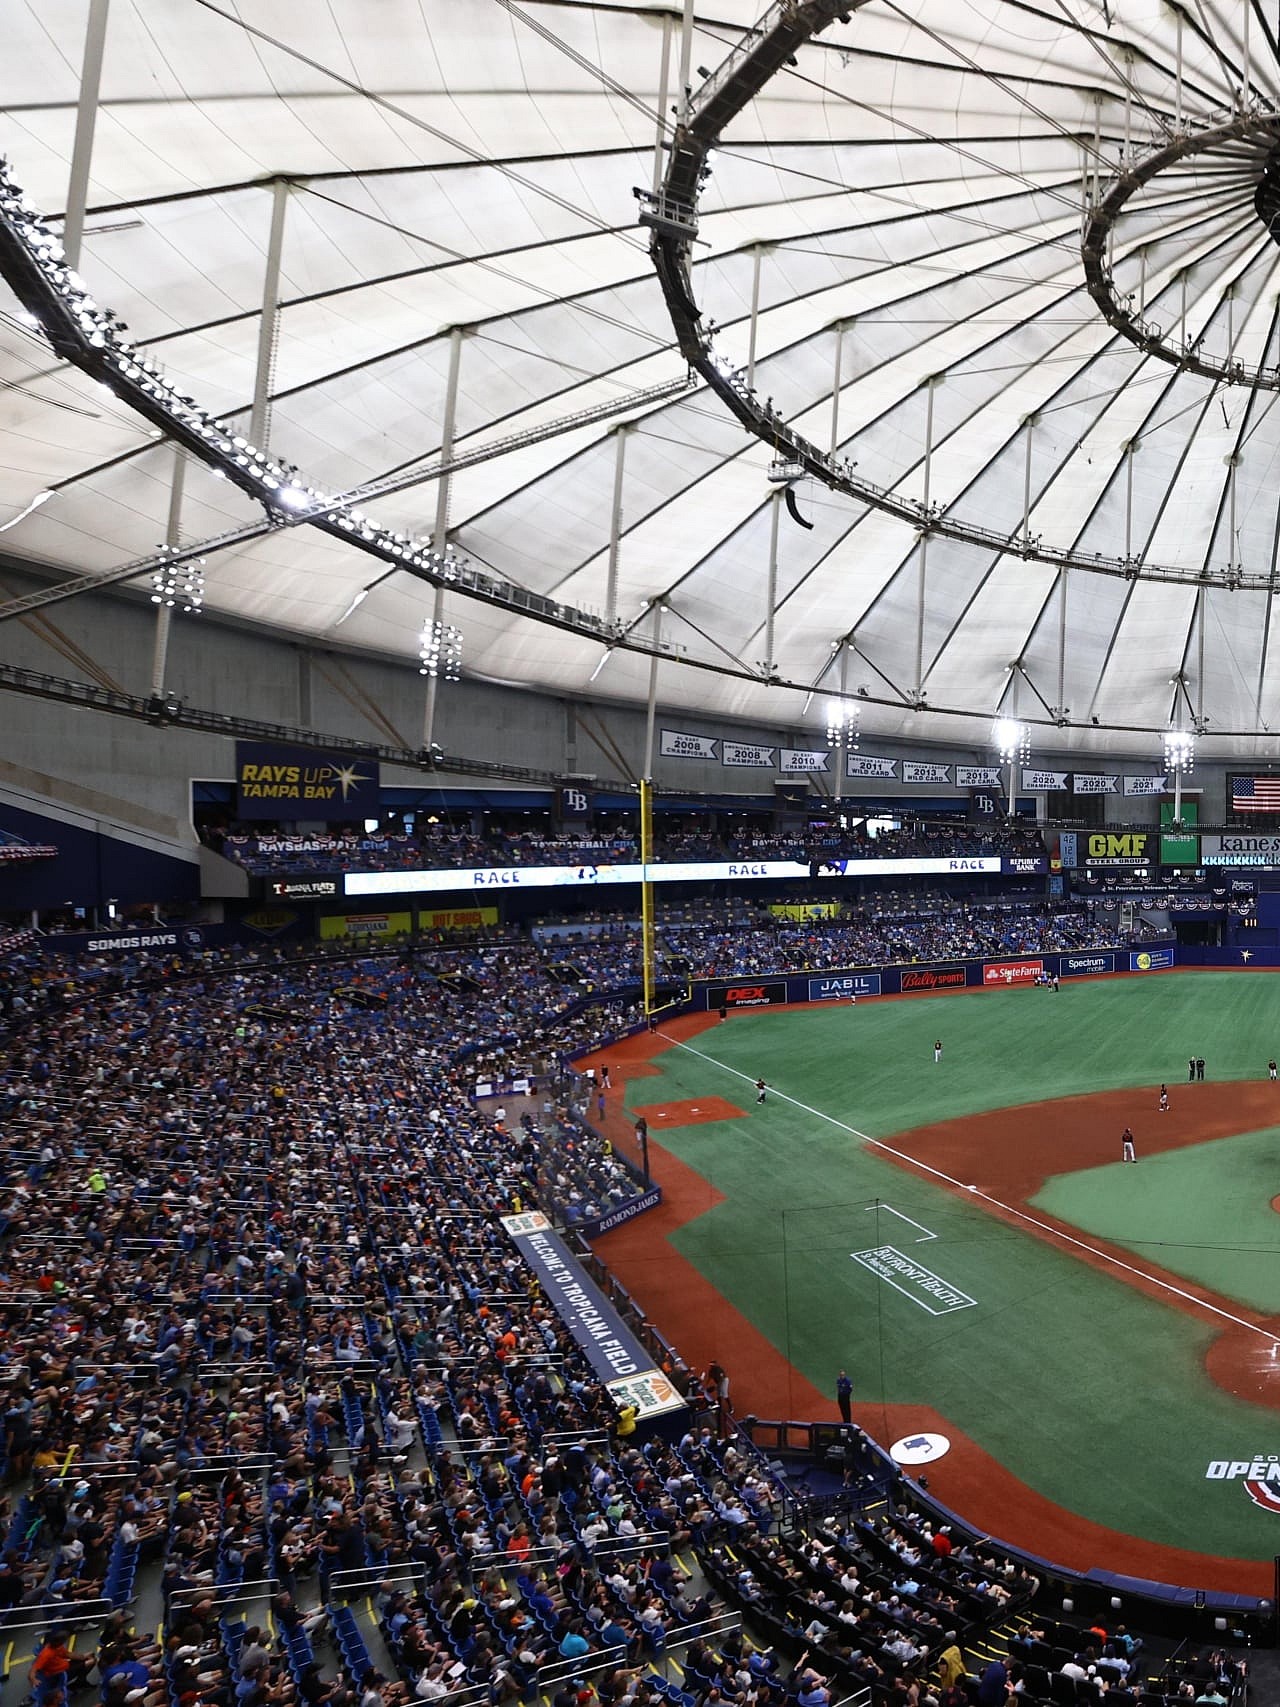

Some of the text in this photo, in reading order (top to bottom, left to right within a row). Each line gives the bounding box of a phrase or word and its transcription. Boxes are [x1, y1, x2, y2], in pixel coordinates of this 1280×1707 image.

[666, 747, 708, 757] CHAMPIONS
[674, 740, 700, 750] 2008
[734, 750, 760, 760] 2008
[860, 762, 882, 770] 2011
[242, 764, 332, 784] RAYS UP
[242, 784, 346, 799] TAMPA BAY
[564, 788, 588, 811] TB
[975, 795, 994, 813] TB
[1064, 835, 1073, 843] 42
[1088, 834, 1146, 857] GMF
[1064, 846, 1072, 854] 12
[728, 864, 768, 876] RACE
[950, 860, 984, 870] RACE
[474, 871, 520, 884] RACE
[88, 934, 176, 951] SOMOS RAYS
[1068, 958, 1104, 969] Spectrum
[821, 978, 869, 991] JABIL
[902, 972, 964, 987] Bally SPORTS
[726, 986, 766, 1000] DEX
[600, 1193, 659, 1231] RAYMOND JAMES
[527, 1232, 565, 1271] WELCOME
[552, 1270, 574, 1283] TO
[874, 1249, 964, 1306] BAYFRONT HEALTH
[560, 1282, 612, 1340] TROPICANA
[598, 1339, 638, 1375] FIELD
